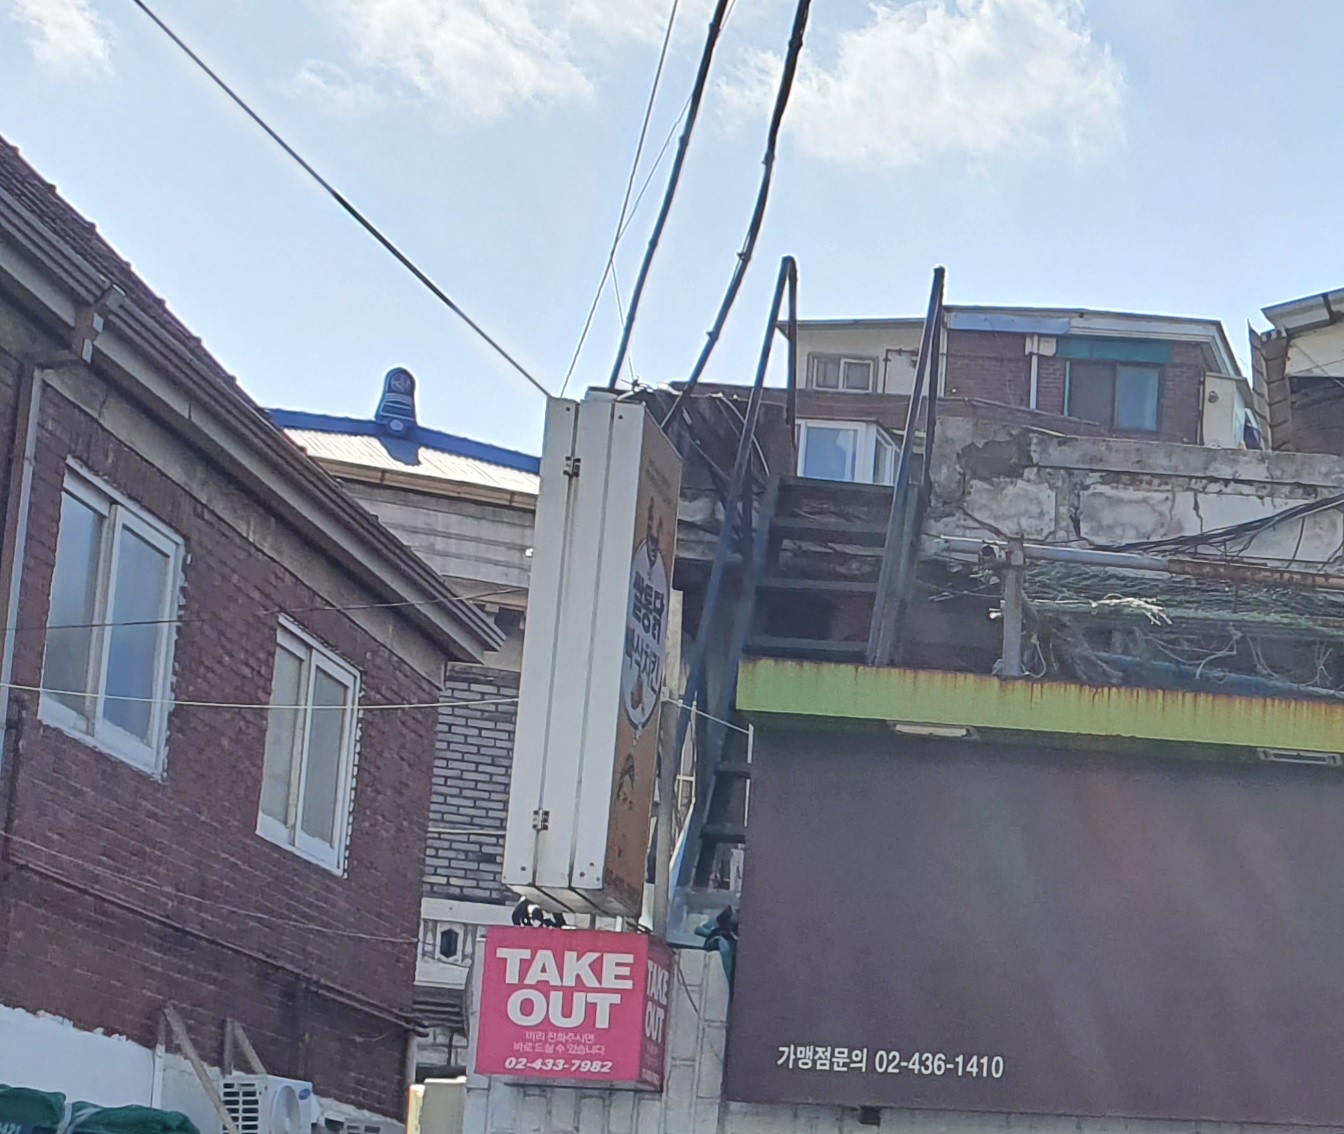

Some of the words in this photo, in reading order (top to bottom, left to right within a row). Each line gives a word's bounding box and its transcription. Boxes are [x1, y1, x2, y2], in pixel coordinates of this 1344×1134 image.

[496, 947, 634, 990] TAKE
[647, 959, 670, 1005] TAKE
[507, 988, 621, 1029] OUT
[645, 1001, 665, 1043] OUT
[504, 1057, 613, 1073] 02-433-7982
[777, 1044, 868, 1072] 가맹점문의
[875, 1050, 1004, 1078] 02-436-1410
